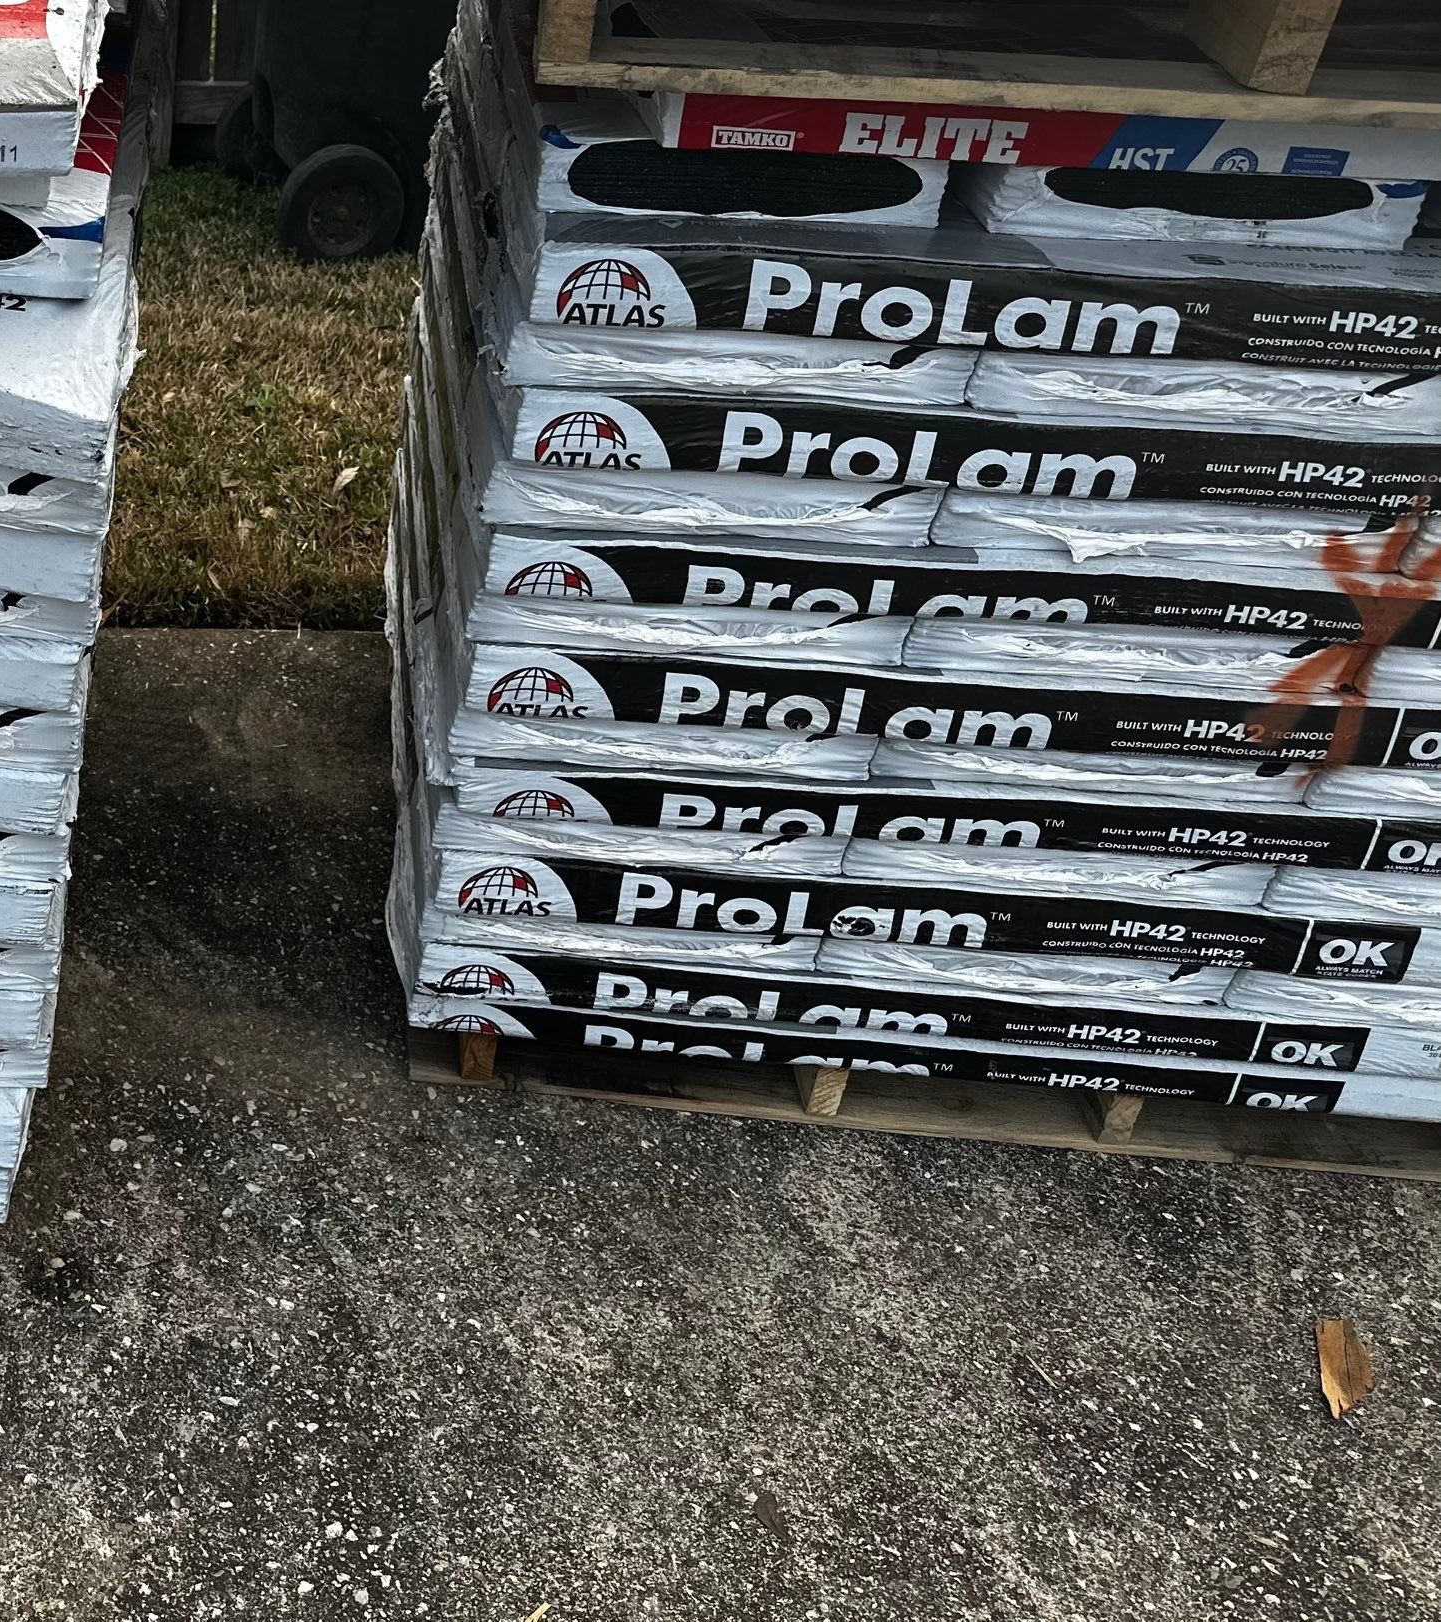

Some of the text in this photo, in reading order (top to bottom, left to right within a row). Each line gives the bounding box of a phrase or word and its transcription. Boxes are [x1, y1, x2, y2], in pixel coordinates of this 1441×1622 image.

[717, 112, 1175, 171] TAMKO ELITE HST
[562, 303, 665, 329] ATLAS
[1253, 313, 1290, 324] BUILT
[1293, 315, 1326, 325] WITH
[1247, 337, 1354, 351] CONSTRUIDO CON
[545, 450, 642, 472] ATLAS
[1206, 463, 1241, 474] BUILT
[1244, 465, 1277, 476] WITH
[1199, 486, 1303, 499] CONSTRUIDO CON
[1154, 605, 1188, 616] BUILT
[1190, 606, 1223, 617] WITH
[1116, 720, 1149, 731] BUILT
[1151, 722, 1182, 732] WITH
[1110, 740, 1329, 761] CONSTRUIDO CON HP42
[1102, 827, 1133, 836] BUILT
[1135, 829, 1166, 838] WITH
[1252, 836, 1331, 849] TECHNOLOGY
[1168, 845, 1191, 854] CON
[465, 899, 552, 918] ATLAS
[1047, 921, 1077, 930] BUILT
[1079, 923, 1108, 932] WITH
[1191, 931, 1266, 945] TECHNOLOGY
[1042, 940, 1106, 949] CONSTRUIDO
[1200, 946, 1245, 959] HP42
[1319, 939, 1395, 967] OK
[1006, 1022, 1035, 1032] BUILT
[1037, 1025, 1066, 1034] WITH
[1146, 1034, 1219, 1047] TECHNOLOGY
[1270, 1040, 1345, 1067] OK
[1018, 1074, 1047, 1083] WITH
[1124, 1083, 1195, 1095] TECHNOLOGY
